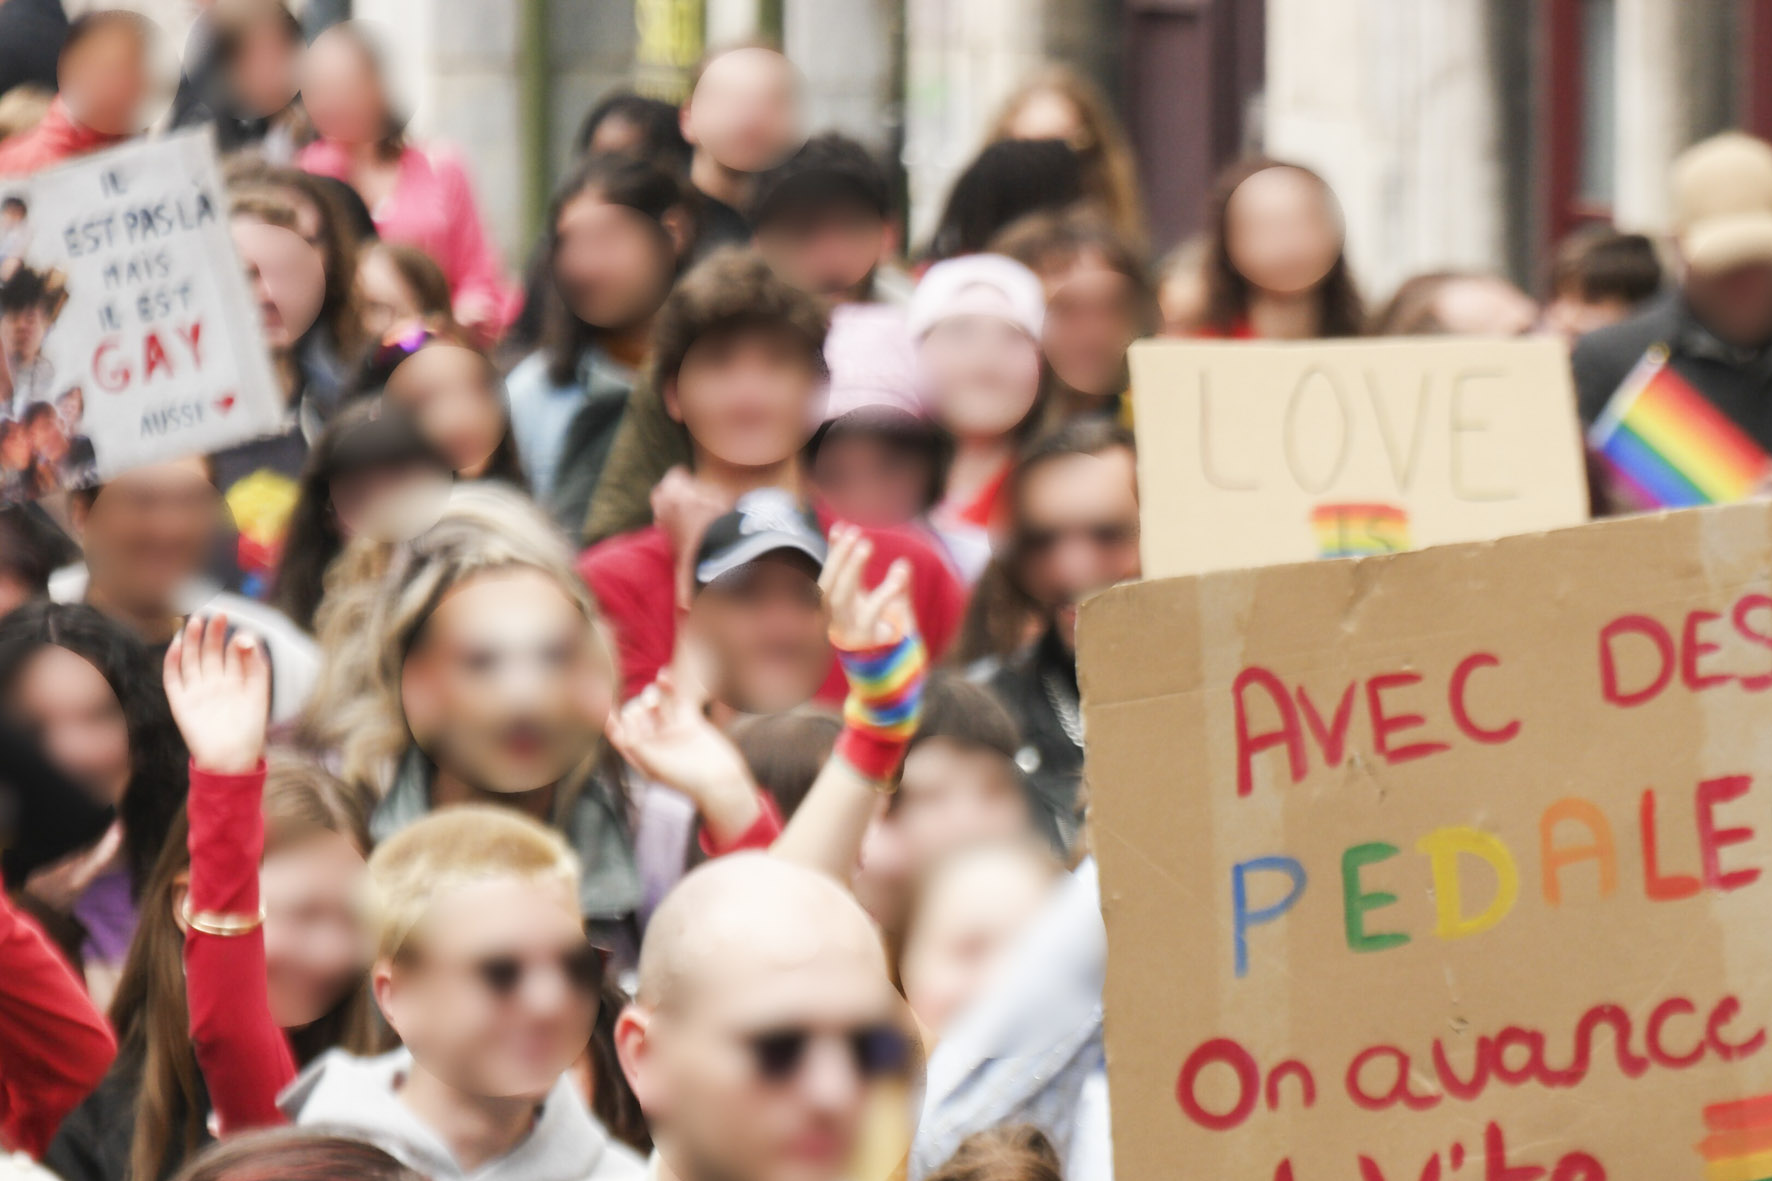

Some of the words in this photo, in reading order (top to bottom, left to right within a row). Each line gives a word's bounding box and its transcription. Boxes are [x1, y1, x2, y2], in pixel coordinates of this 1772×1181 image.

[100, 171, 127, 198] IL
[63, 215, 114, 258] EST
[122, 202, 174, 245] PAS
[103, 251, 171, 289] MAIS
[98, 302, 121, 331] IL
[136, 281, 191, 323] EST
[91, 319, 204, 395] GAY
[1199, 361, 1521, 502] LOVE
[1231, 652, 1521, 798] AVEC
[1176, 1038, 1317, 1131] On
[1344, 994, 1766, 1112] avance
